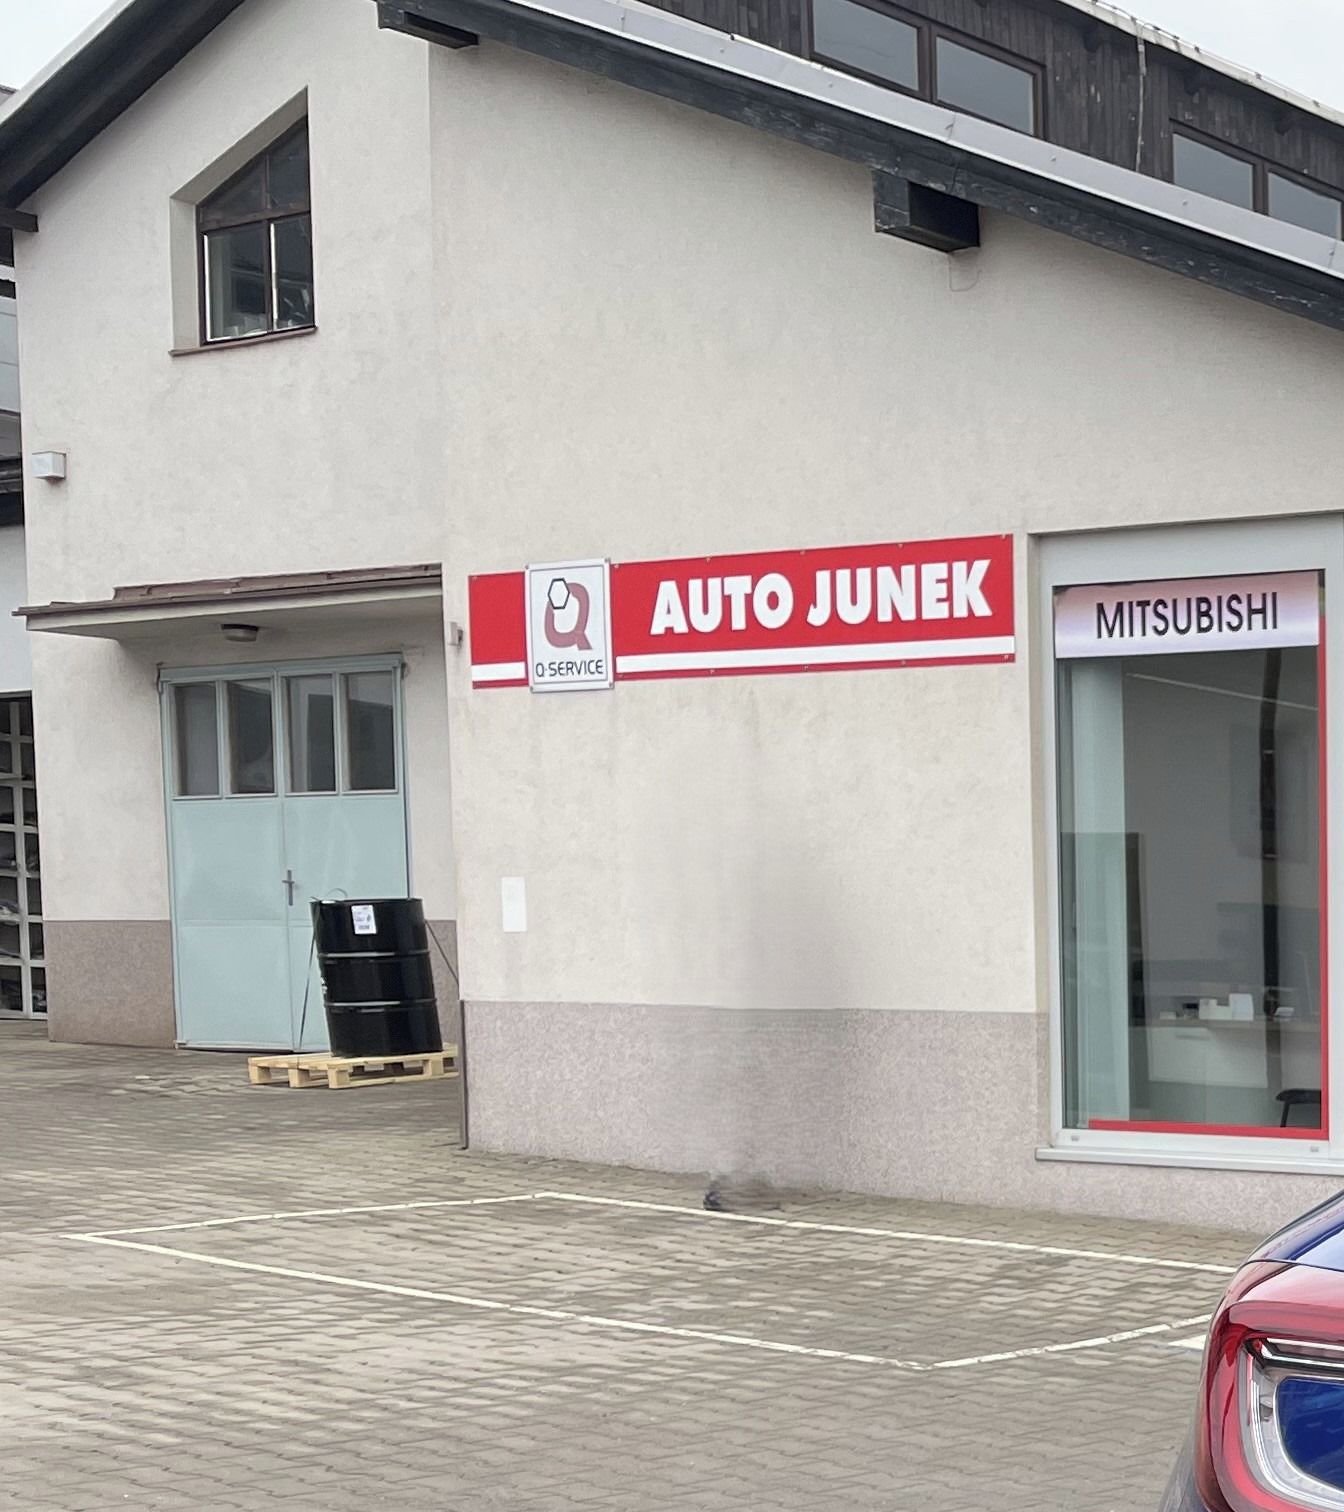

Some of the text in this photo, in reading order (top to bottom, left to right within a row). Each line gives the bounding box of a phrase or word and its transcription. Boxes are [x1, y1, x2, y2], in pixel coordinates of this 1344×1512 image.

[650, 559, 993, 635] AUTO JUNEK
[1096, 591, 1278, 639] MITSUBISHI
